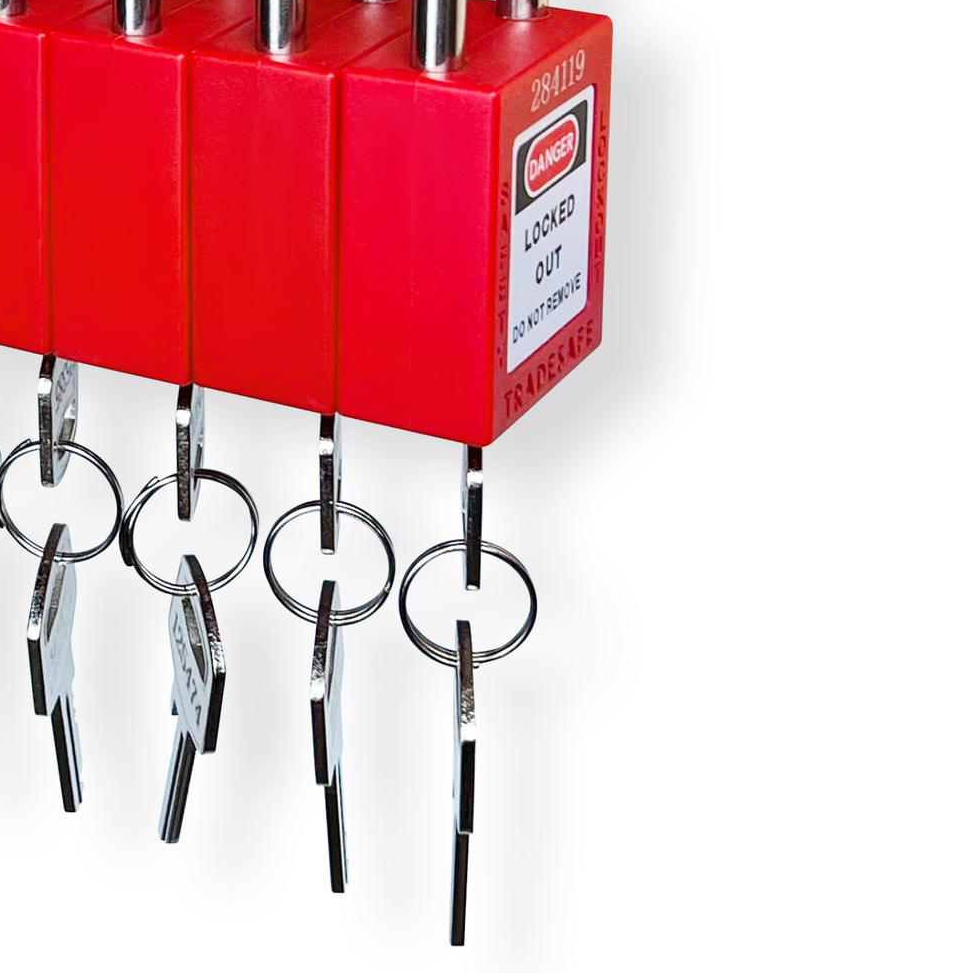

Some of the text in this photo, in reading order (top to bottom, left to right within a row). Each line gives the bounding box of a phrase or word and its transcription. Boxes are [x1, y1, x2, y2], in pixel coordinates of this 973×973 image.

[530, 49, 586, 113] 284119
[528, 131, 575, 182] DANGER
[524, 193, 576, 253] LOCKED
[535, 243, 563, 285] OUT
[512, 271, 582, 345] DO NOT REMOVE
[504, 318, 595, 419] TRADESAFE
